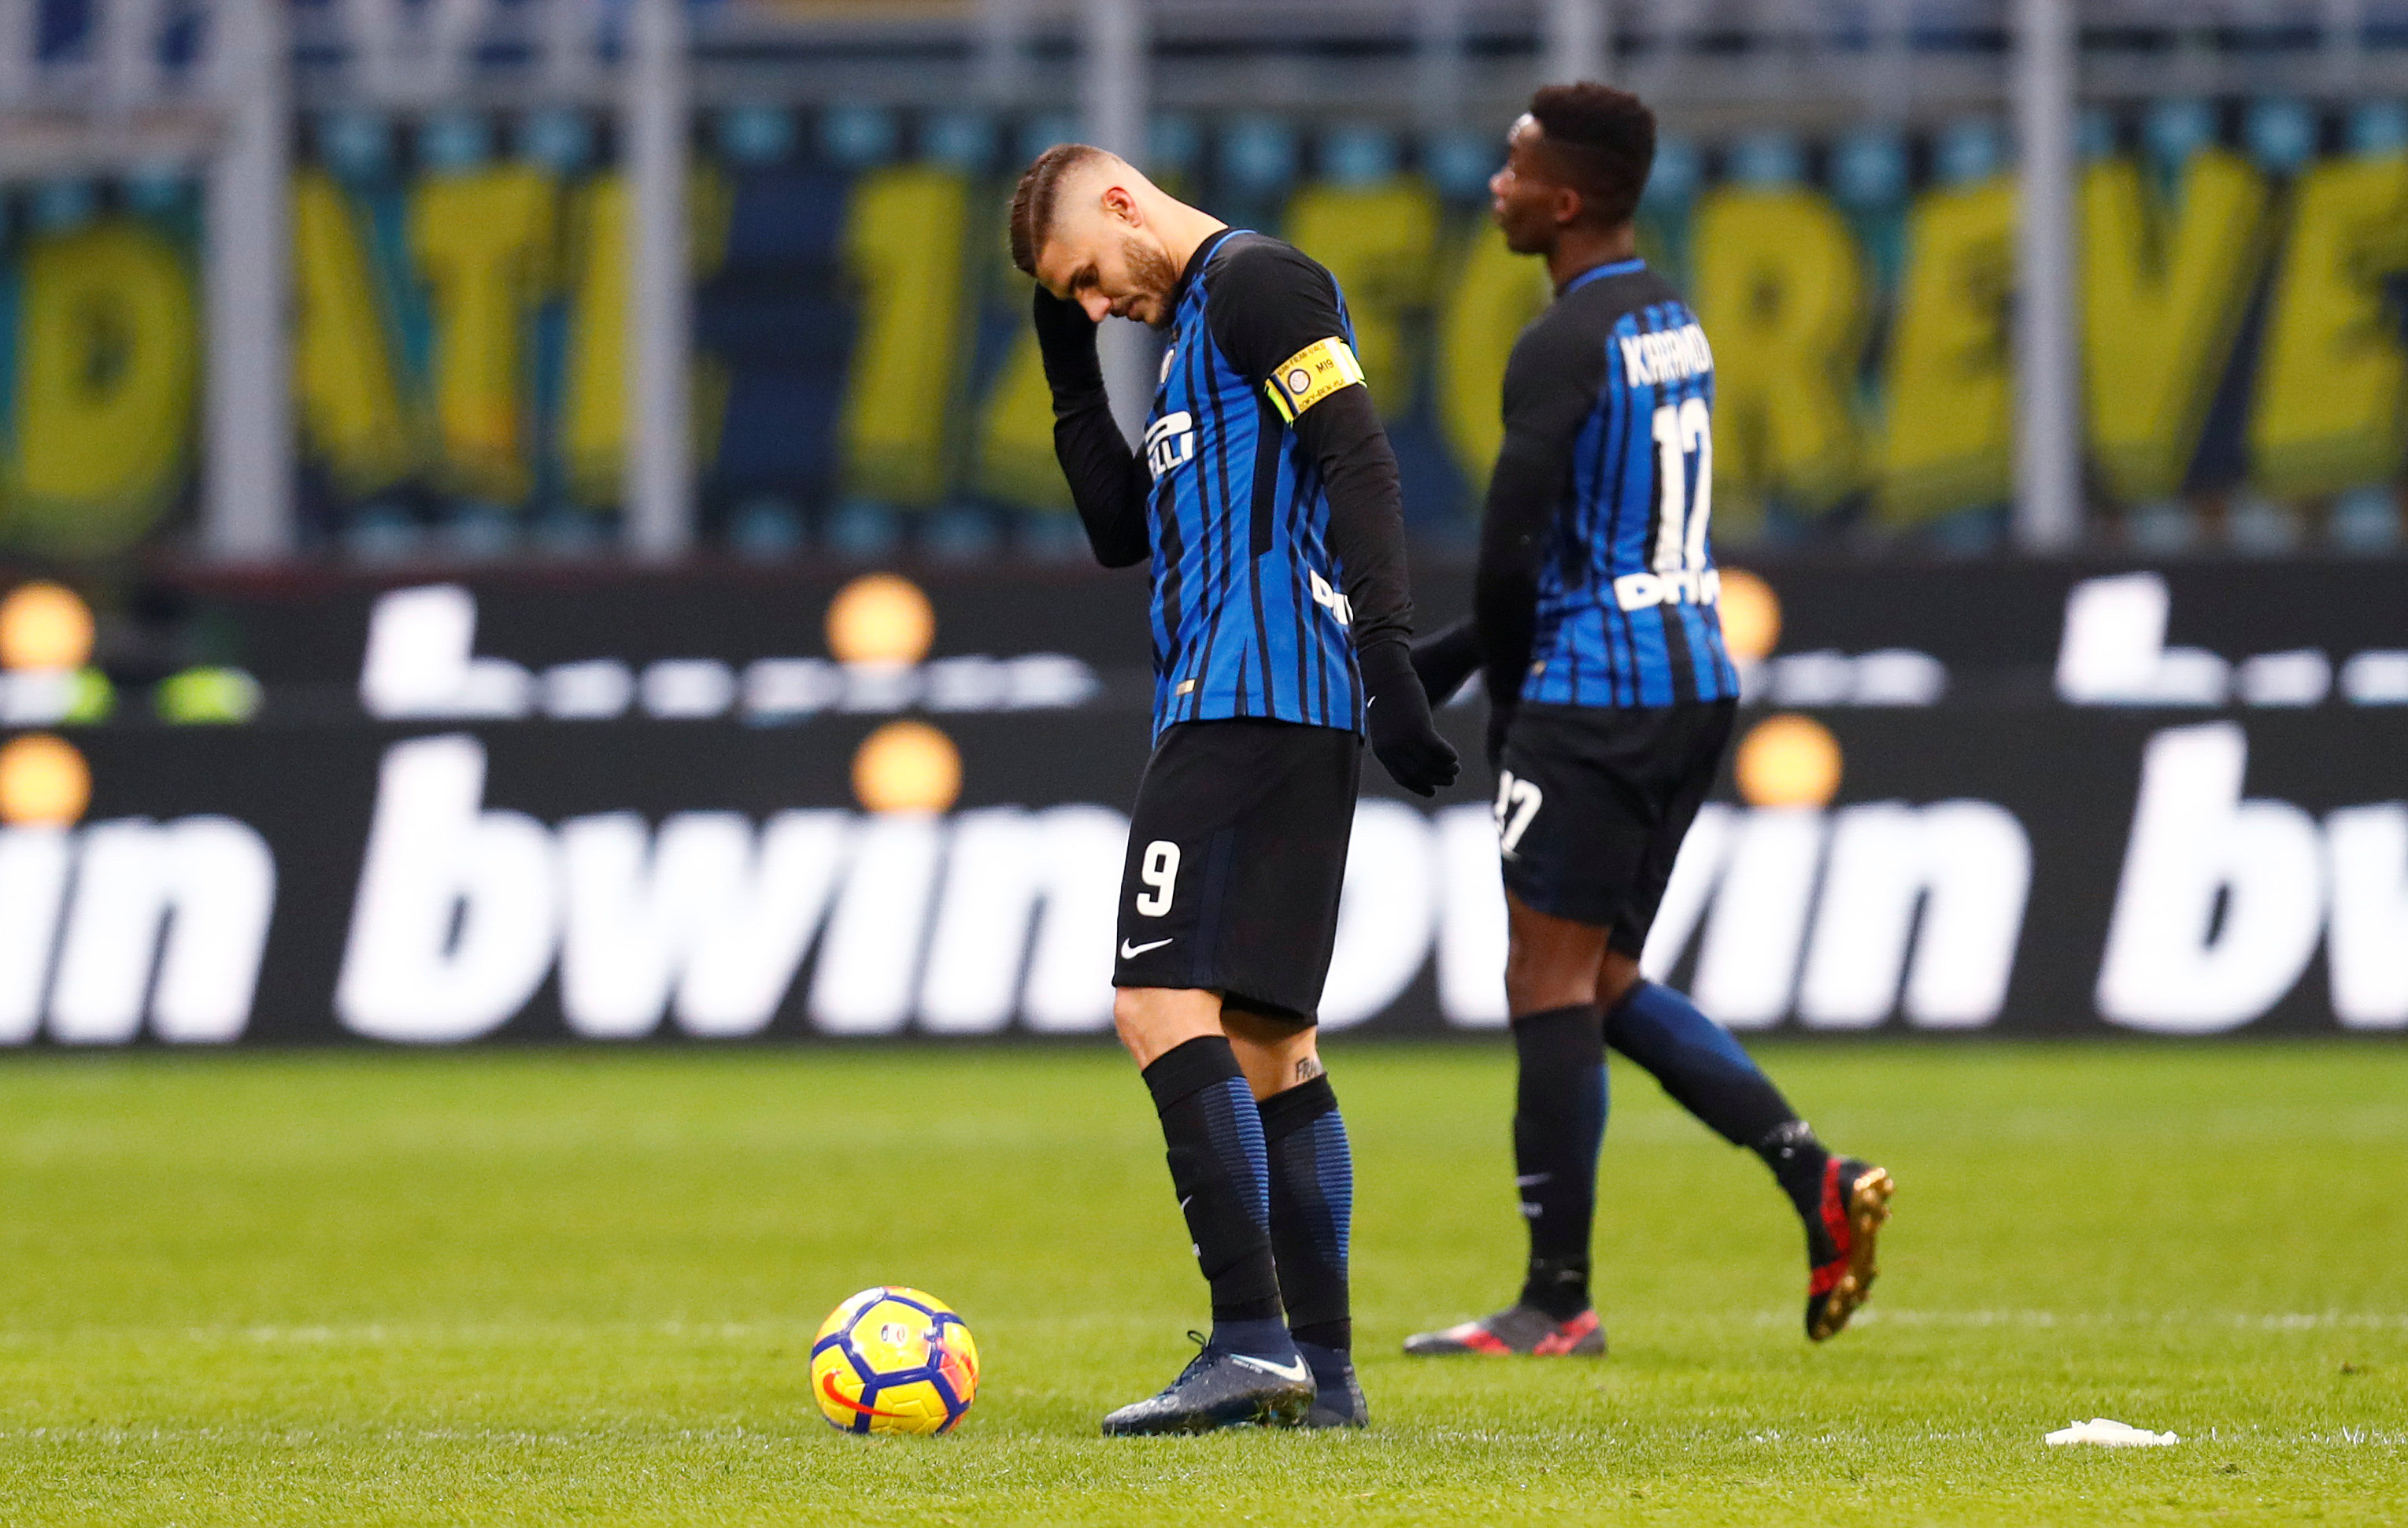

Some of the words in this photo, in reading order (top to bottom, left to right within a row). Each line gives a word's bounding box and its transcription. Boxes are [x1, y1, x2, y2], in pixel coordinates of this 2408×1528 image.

[1652, 398, 1712, 573] 17
[332, 718, 1132, 1044] bwin
[1136, 840, 1181, 917] 9
